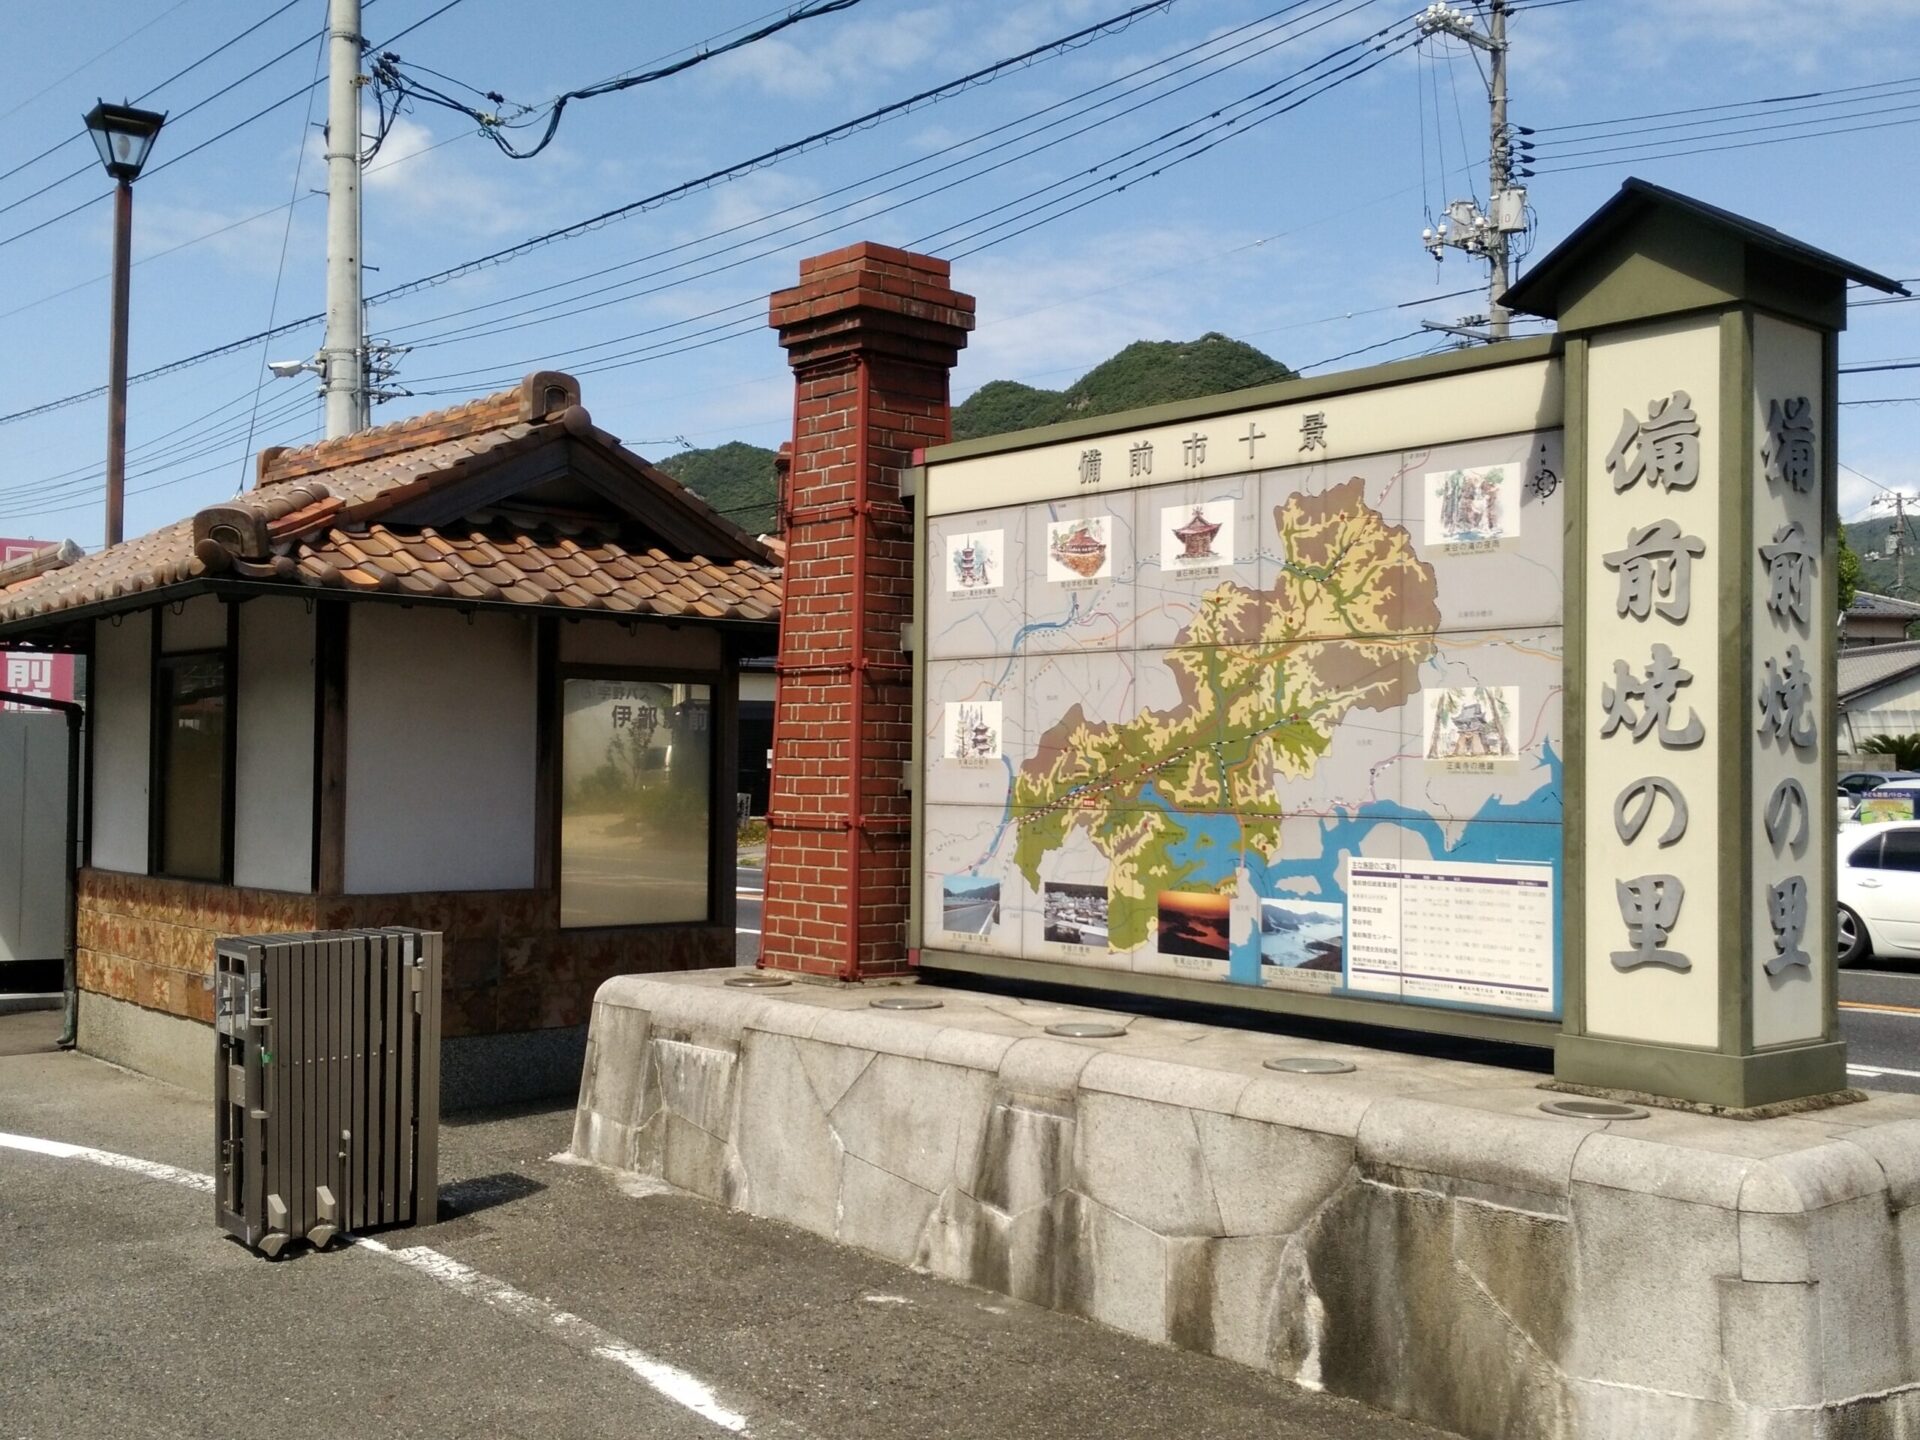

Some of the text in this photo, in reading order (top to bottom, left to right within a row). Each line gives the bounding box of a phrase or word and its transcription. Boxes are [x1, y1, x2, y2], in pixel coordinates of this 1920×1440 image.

[1078, 411, 1328, 485] 備前市十景
[611, 704, 708, 732] 伊部前
[1599, 389, 1706, 974] 備前焼の里
[1757, 396, 1818, 980] 備前焼の里
